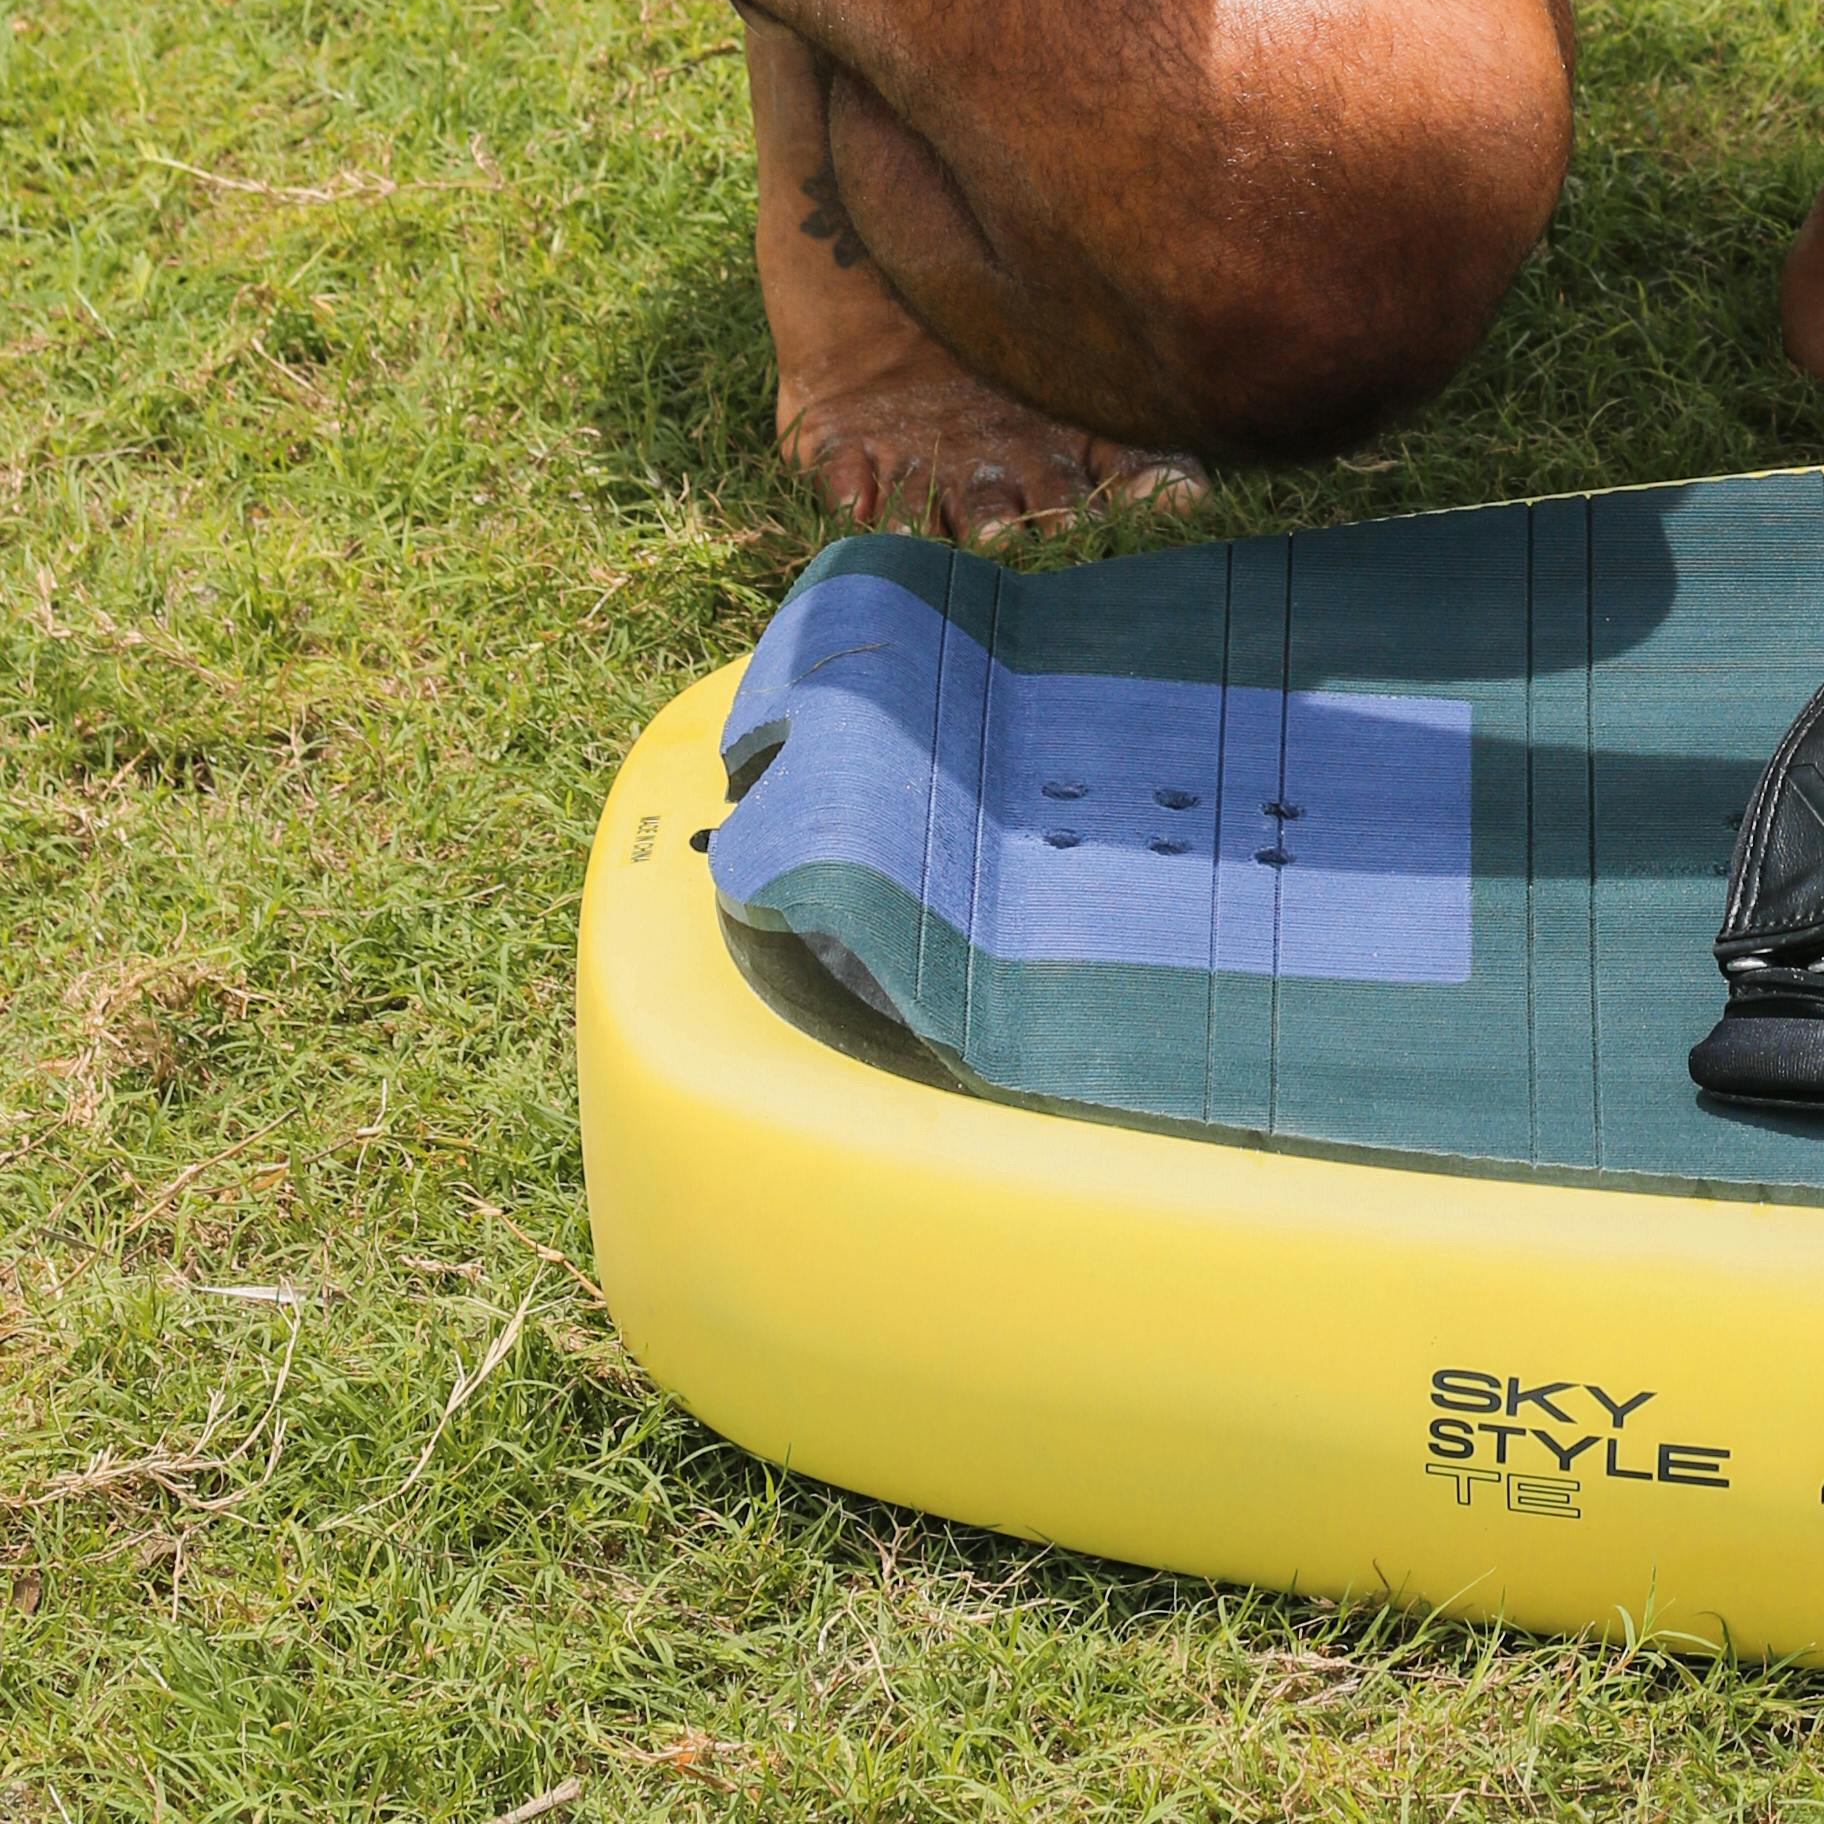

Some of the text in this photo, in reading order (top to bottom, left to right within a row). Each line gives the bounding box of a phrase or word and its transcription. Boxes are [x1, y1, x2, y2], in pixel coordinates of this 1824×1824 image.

[1431, 1369, 1657, 1429] SKY
[1427, 1419, 1731, 1489] STYLE
[1426, 1463, 1581, 1519] TE
